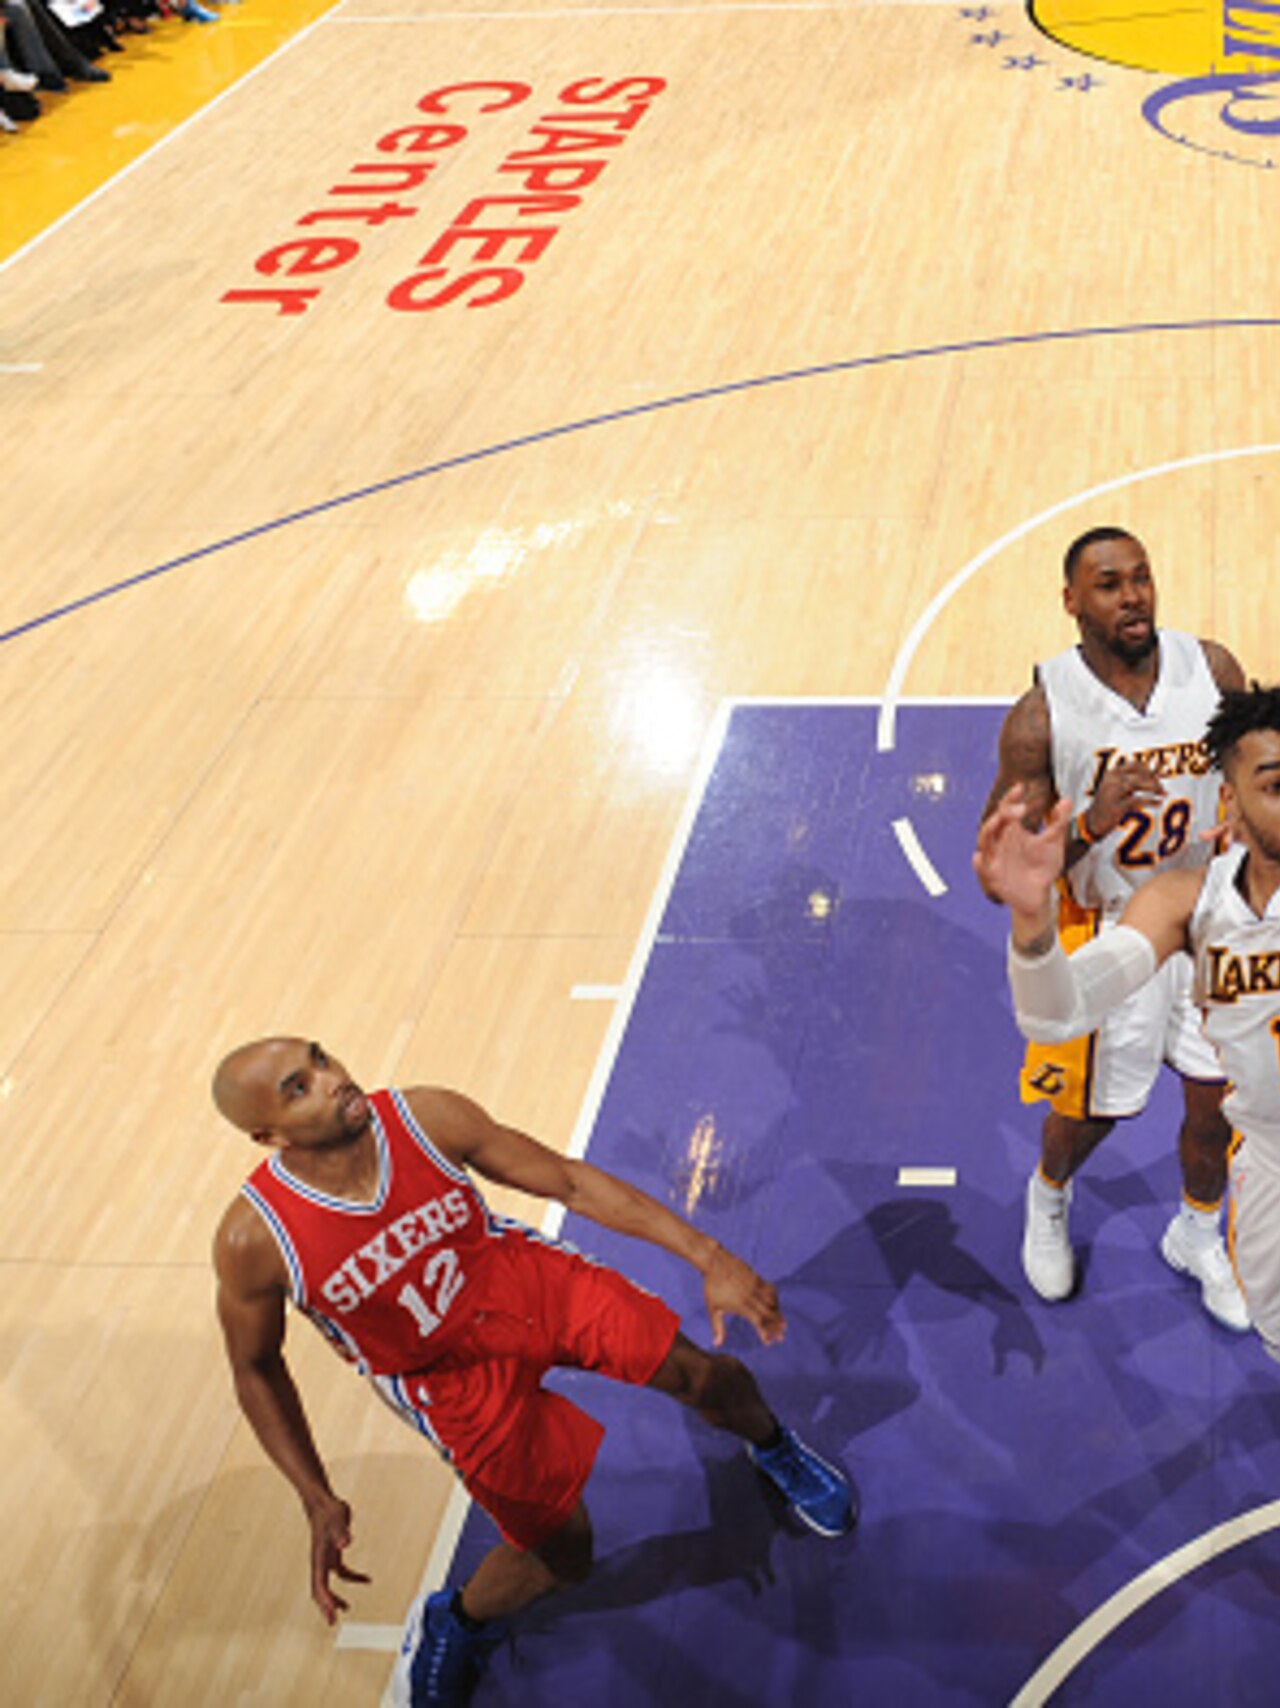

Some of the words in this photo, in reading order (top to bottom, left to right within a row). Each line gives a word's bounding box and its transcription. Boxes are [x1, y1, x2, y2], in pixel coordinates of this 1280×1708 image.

[219, 81, 532, 316] Center
[386, 76, 667, 312] STAPLES
[1115, 797, 1193, 870] 28
[321, 1189, 473, 1315] SIXERS
[397, 1247, 465, 1338] 12
